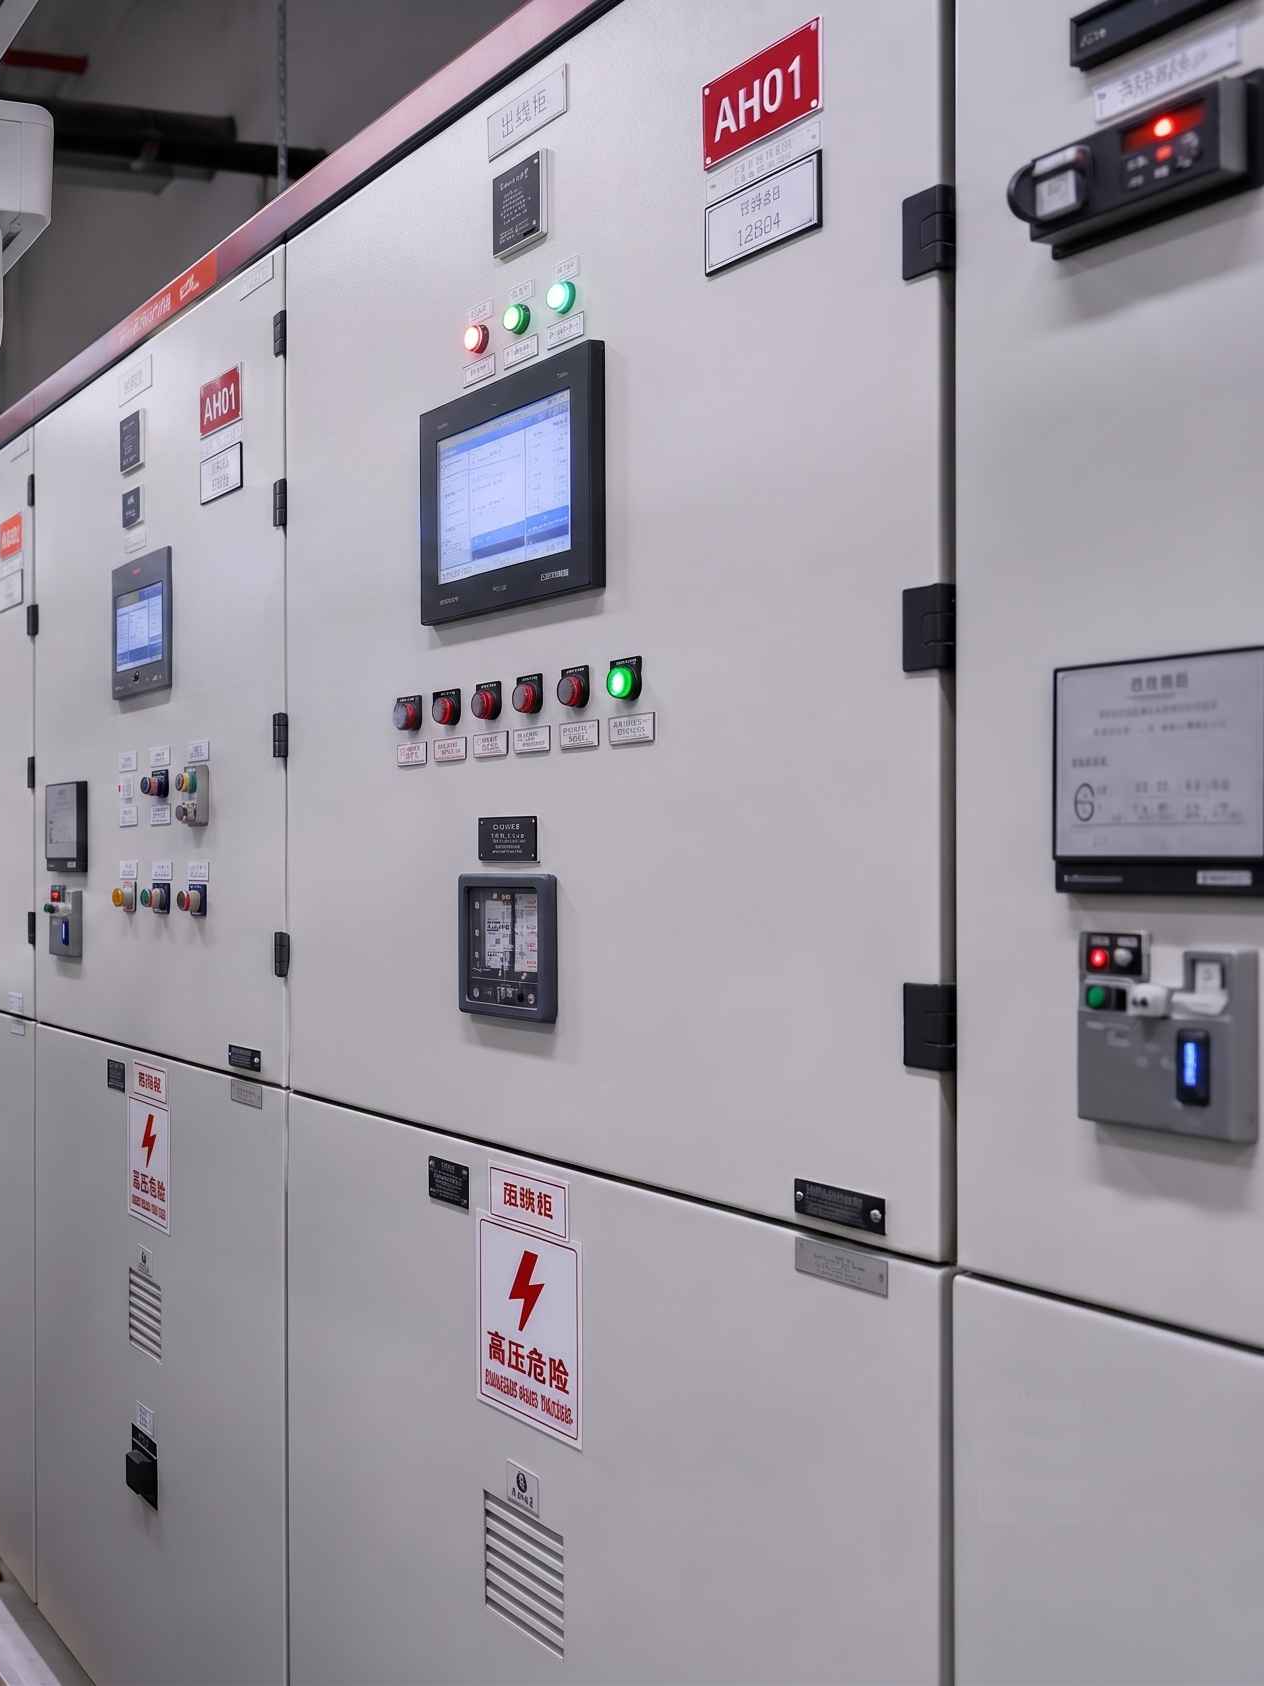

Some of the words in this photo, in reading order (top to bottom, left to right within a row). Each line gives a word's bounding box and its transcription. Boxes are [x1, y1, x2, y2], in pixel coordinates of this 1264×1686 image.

[714, 54, 801, 143] AH01
[203, 382, 236, 425] AH01
[487, 1330, 570, 1395] 高压危险
